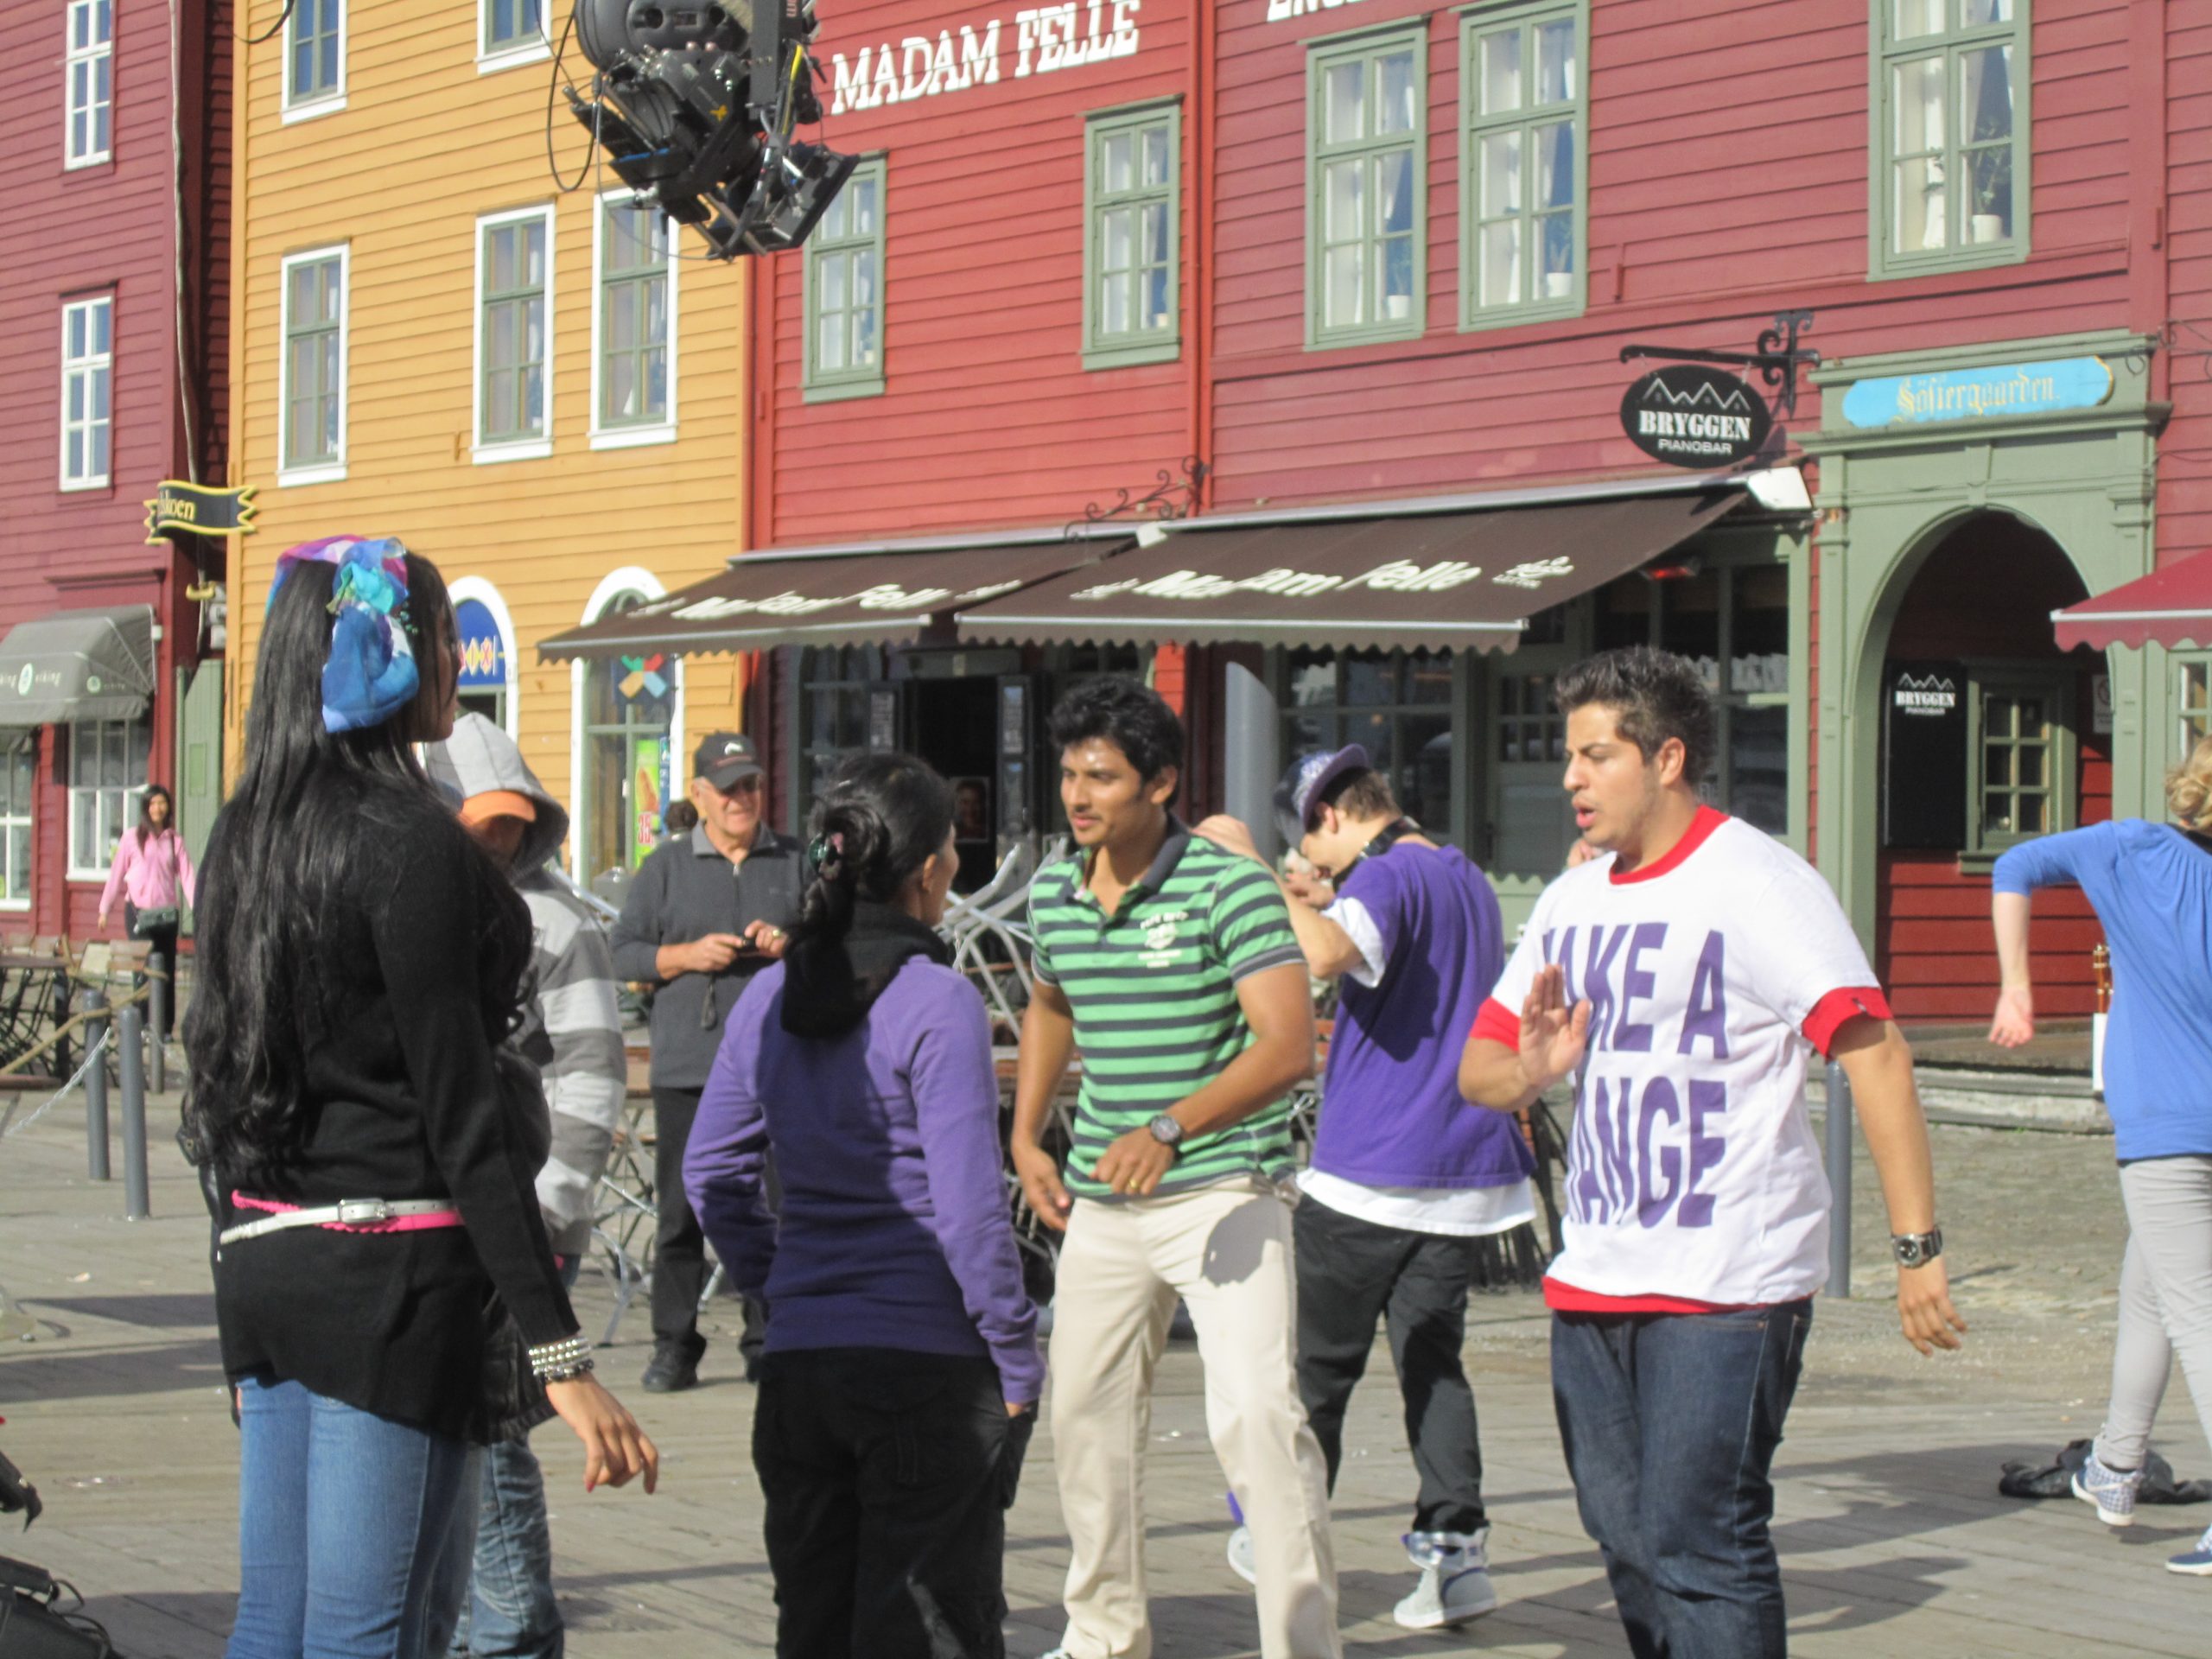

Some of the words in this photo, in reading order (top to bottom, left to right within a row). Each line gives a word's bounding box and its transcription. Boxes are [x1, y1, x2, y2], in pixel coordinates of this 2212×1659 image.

[830, 19, 1003, 116] MADAM
[1014, 0, 1141, 78] FELLE
[1639, 410, 1751, 441] BRYGGEN
[1657, 438, 1732, 454] PIANOBAR
[1895, 690, 1955, 708] BRYGGEN
[1542, 922, 1669, 1052] AKE
[1676, 929, 1729, 1059] A
